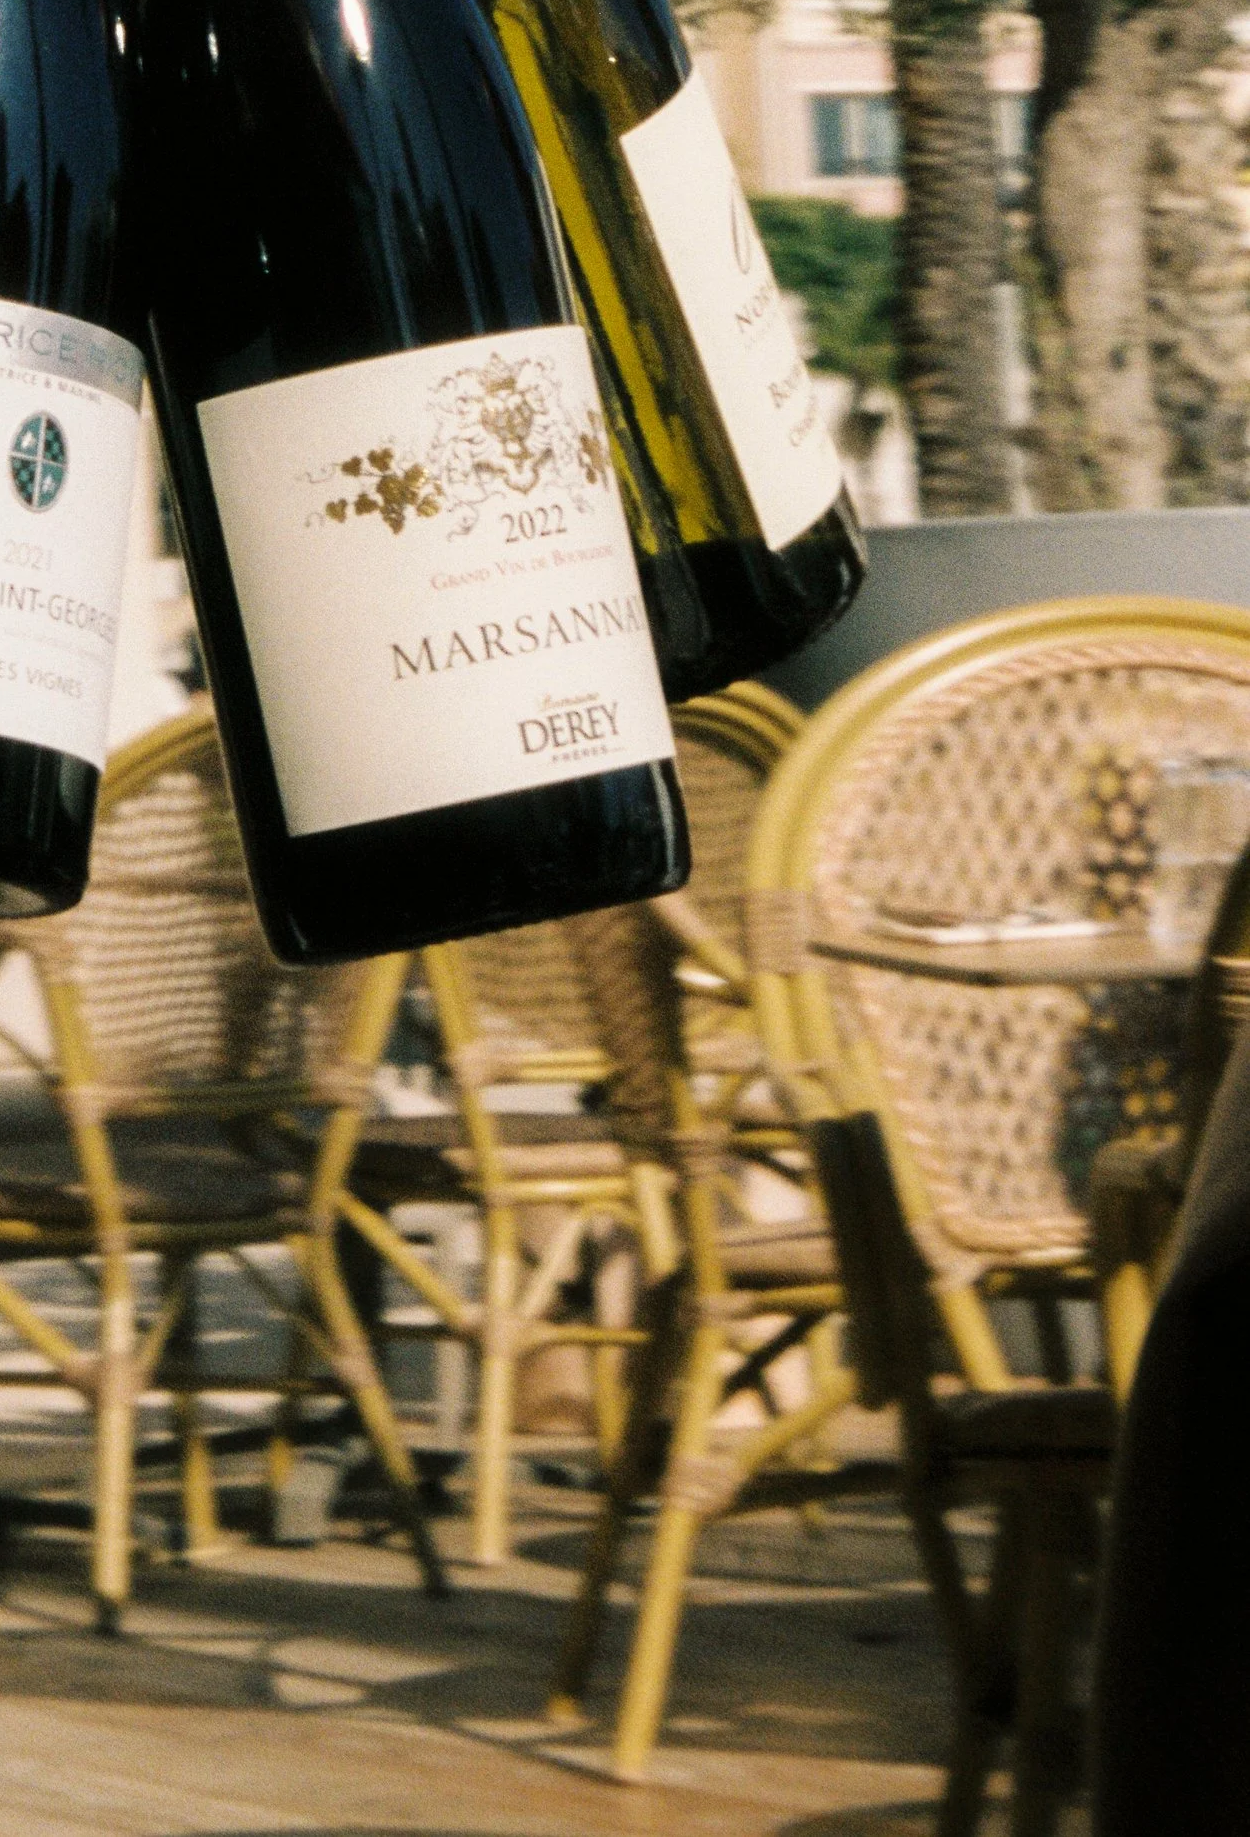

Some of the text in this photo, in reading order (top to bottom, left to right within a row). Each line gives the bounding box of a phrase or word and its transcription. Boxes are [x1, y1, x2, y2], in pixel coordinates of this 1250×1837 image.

[501, 502, 568, 544] 2022
[26, 665, 84, 701] VIGNES
[517, 700, 620, 755] DEREY
